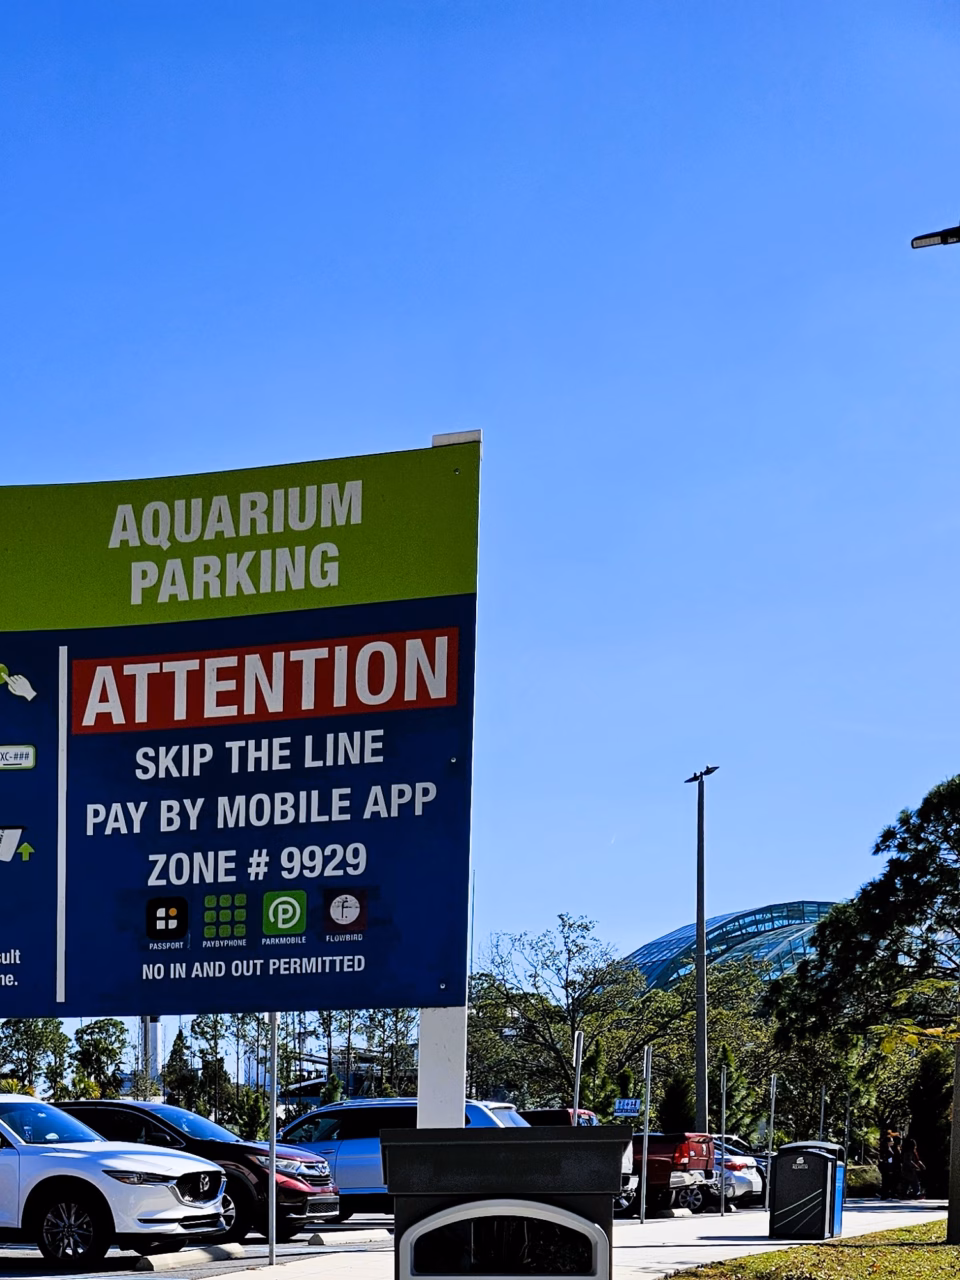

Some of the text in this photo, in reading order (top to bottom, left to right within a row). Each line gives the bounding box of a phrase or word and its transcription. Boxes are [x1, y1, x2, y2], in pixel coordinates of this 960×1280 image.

[108, 480, 363, 550] AQUARIUM
[131, 542, 339, 604] PARKING
[82, 636, 447, 726] ATTENTION
[136, 729, 383, 779] SKIP THE LINE
[87, 782, 436, 835] PAY BY MOBILE APP
[148, 843, 366, 886] ZONE # 9929
[203, 939, 246, 947] PAYBYPHONE
[262, 936, 306, 944] PARKMOBILE
[326, 934, 362, 942] FLOWBIRD
[143, 956, 365, 979] NO IN AND OUT PERMITTED
